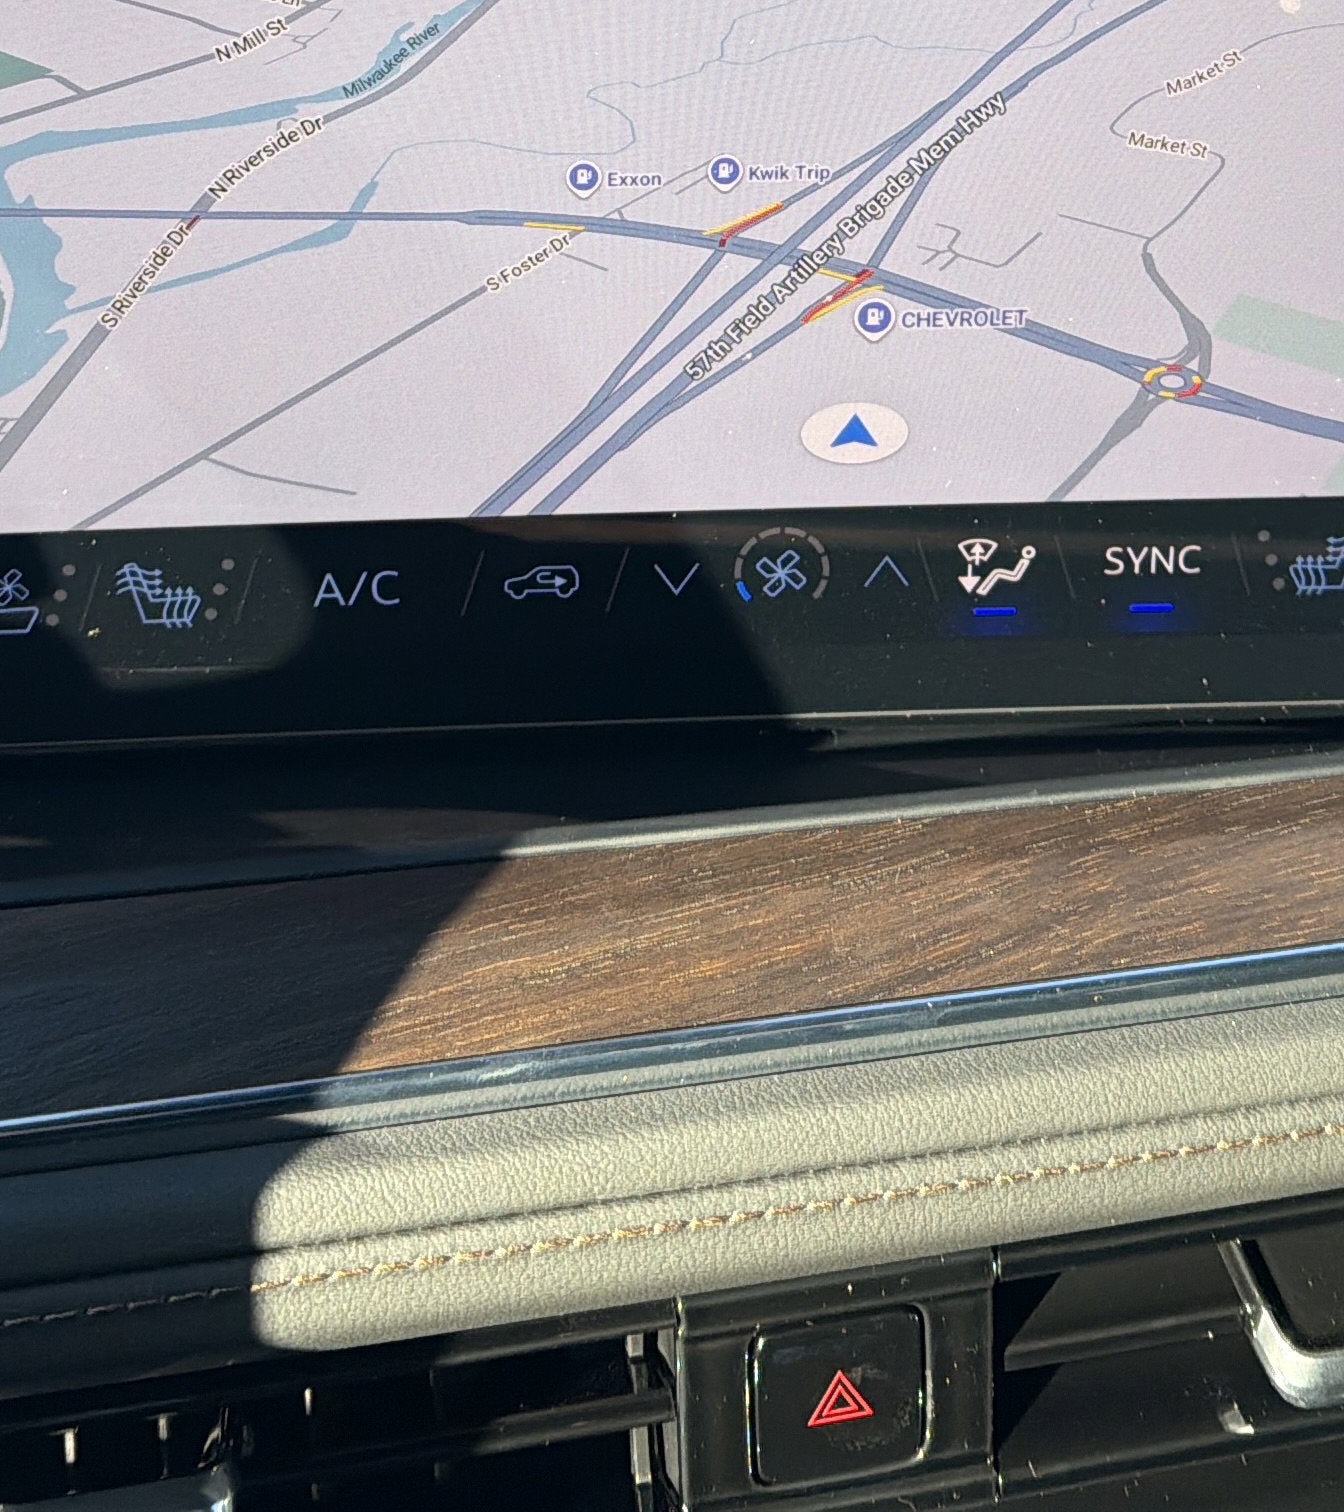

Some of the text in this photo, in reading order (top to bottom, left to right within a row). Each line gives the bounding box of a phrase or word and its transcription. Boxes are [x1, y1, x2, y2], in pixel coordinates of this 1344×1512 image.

[215, 18, 287, 61] N Mill St
[343, 23, 440, 97] Milwaukee River
[1166, 51, 1241, 95] Market St
[209, 117, 323, 198] N Riverside Dr
[1128, 132, 1207, 157] Market St
[608, 172, 661, 187] Exxon
[749, 165, 830, 183] Kwik Trip
[685, 92, 1007, 381] 57th Field Artillery Brigade Mem Hwy
[102, 227, 189, 328] S Riverside Dr
[487, 234, 570, 290] S Foster Dr
[902, 309, 1027, 328] CHEVROLET
[1104, 544, 1201, 575] SYNC
[313, 571, 400, 609] A/C
